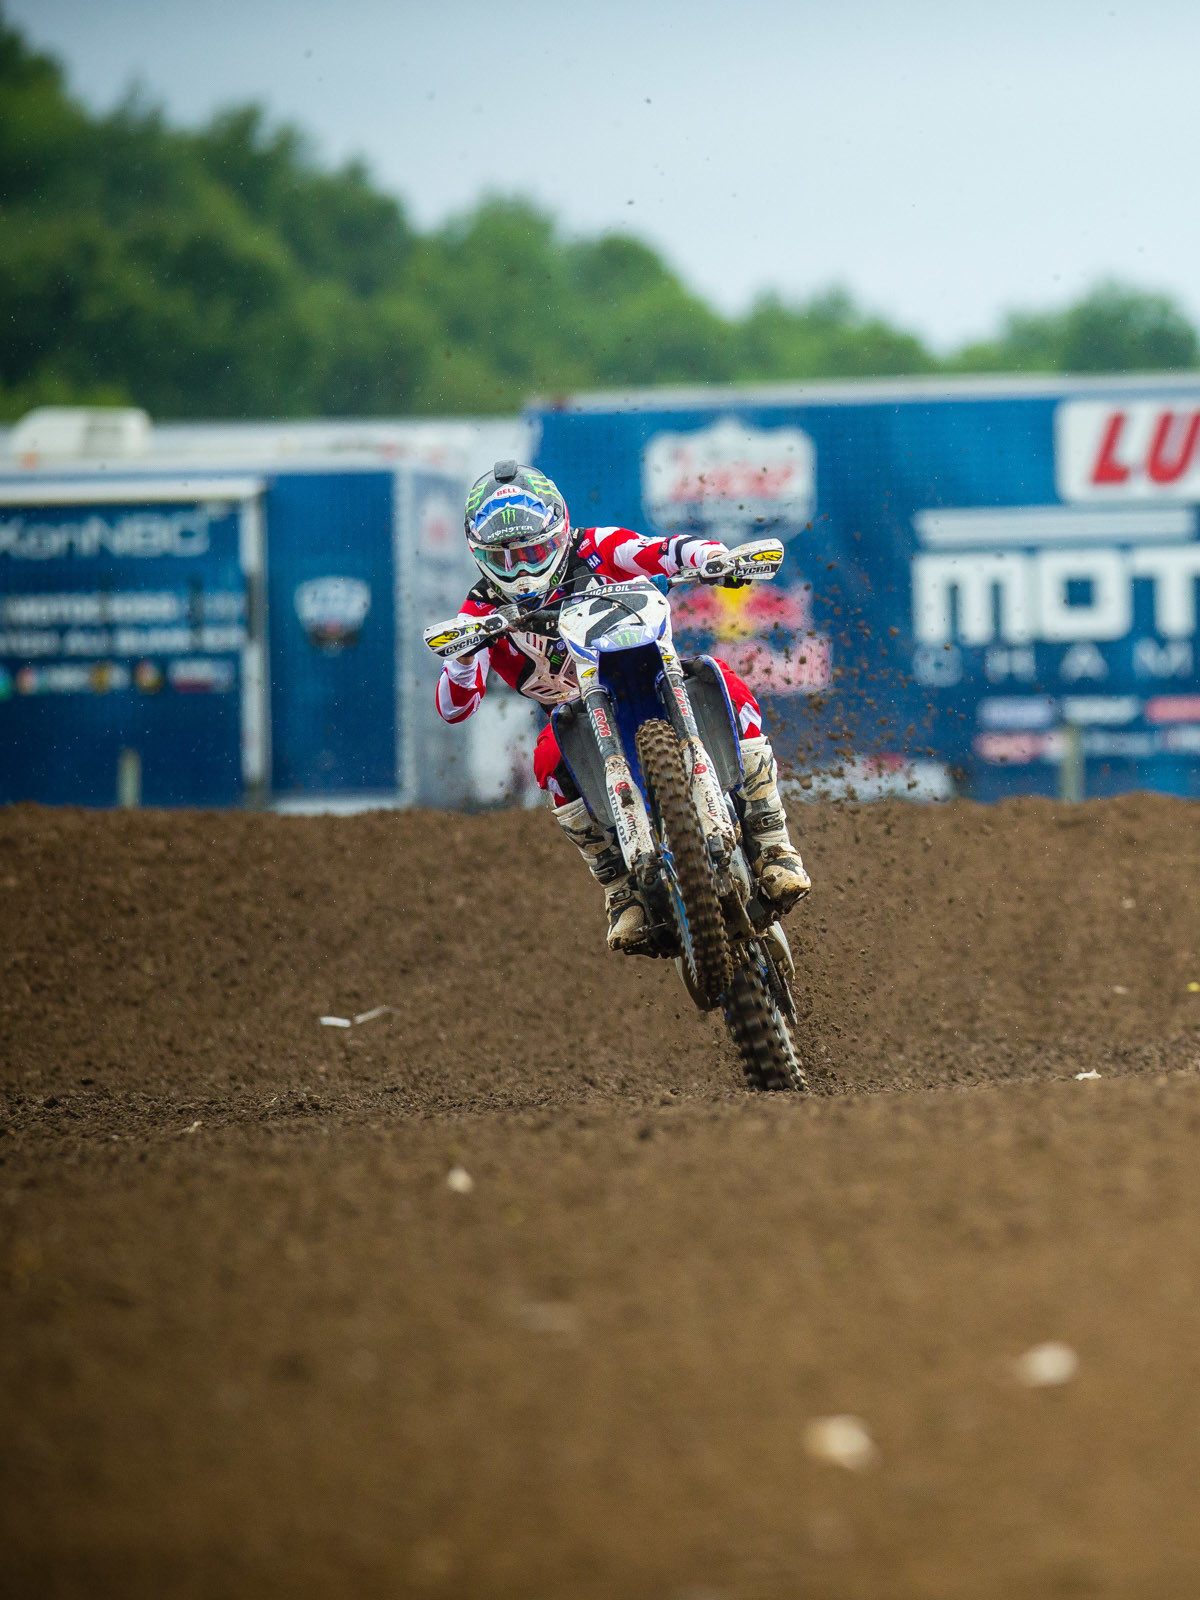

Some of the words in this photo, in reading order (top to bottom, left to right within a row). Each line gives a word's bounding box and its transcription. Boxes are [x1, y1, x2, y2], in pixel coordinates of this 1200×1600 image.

[496, 488, 518, 497] BELL
[487, 525, 535, 541] MONSTER
[734, 565, 770, 576] CYCRA
[445, 634, 479, 654] CYCRA
[607, 785, 629, 846] DUNLOP
